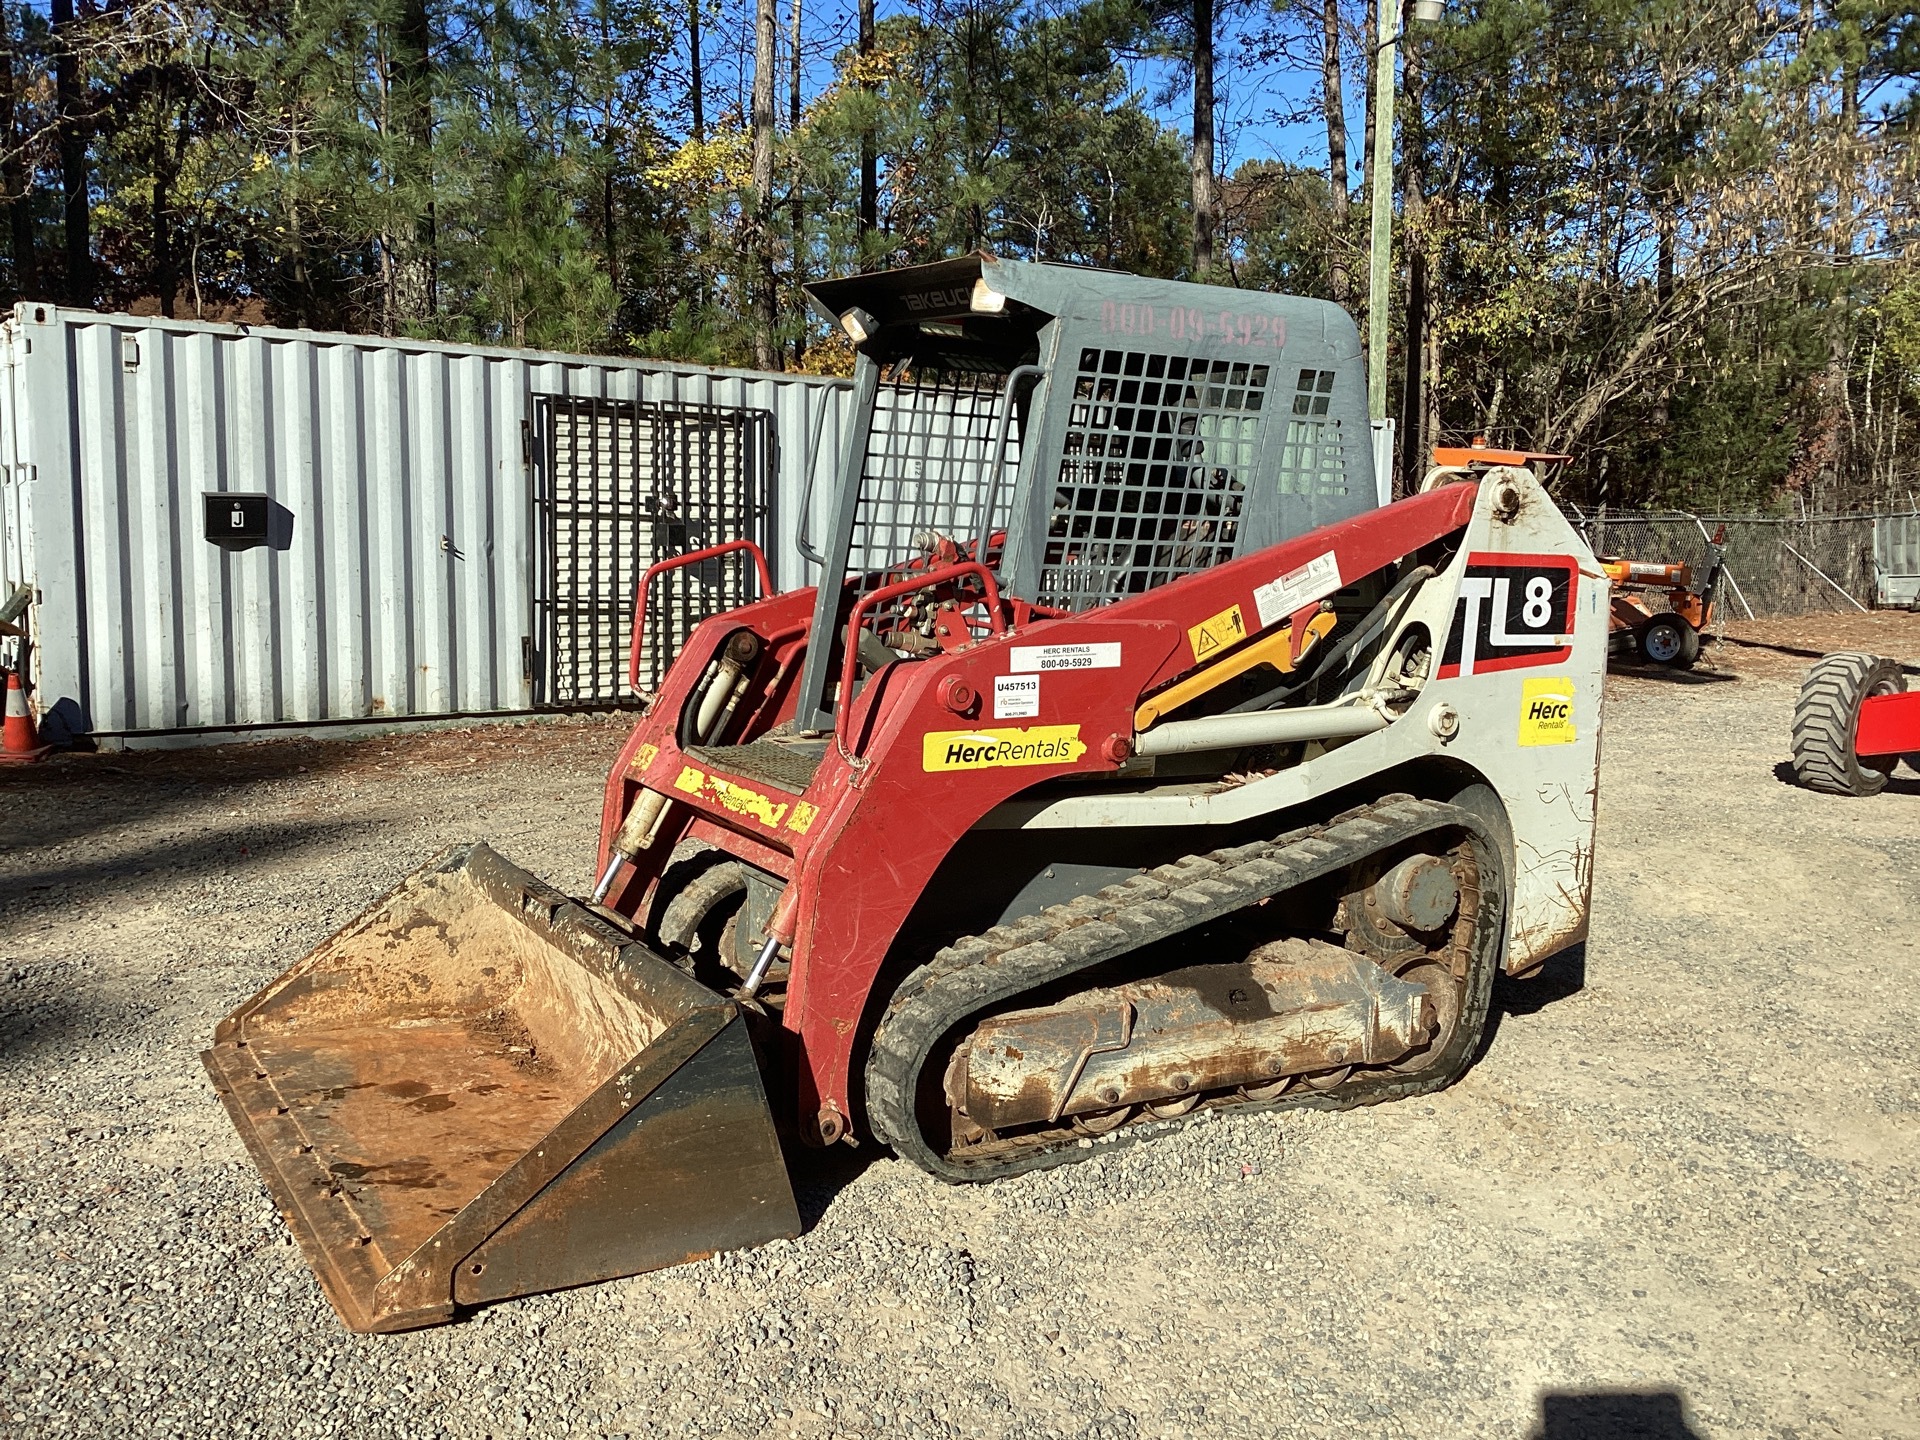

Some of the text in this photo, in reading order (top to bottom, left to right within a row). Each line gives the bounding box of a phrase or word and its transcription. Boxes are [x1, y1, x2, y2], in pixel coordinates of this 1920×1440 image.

[233, 512, 242, 526] J
[1458, 576, 1573, 678] TL8
[1043, 646, 1090, 655] HERC RENTALS
[1041, 657, 1092, 669] 800-09-5929
[997, 682, 1036, 691] U457513
[1528, 701, 1568, 720] Herc
[1537, 720, 1564, 730] Rentals
